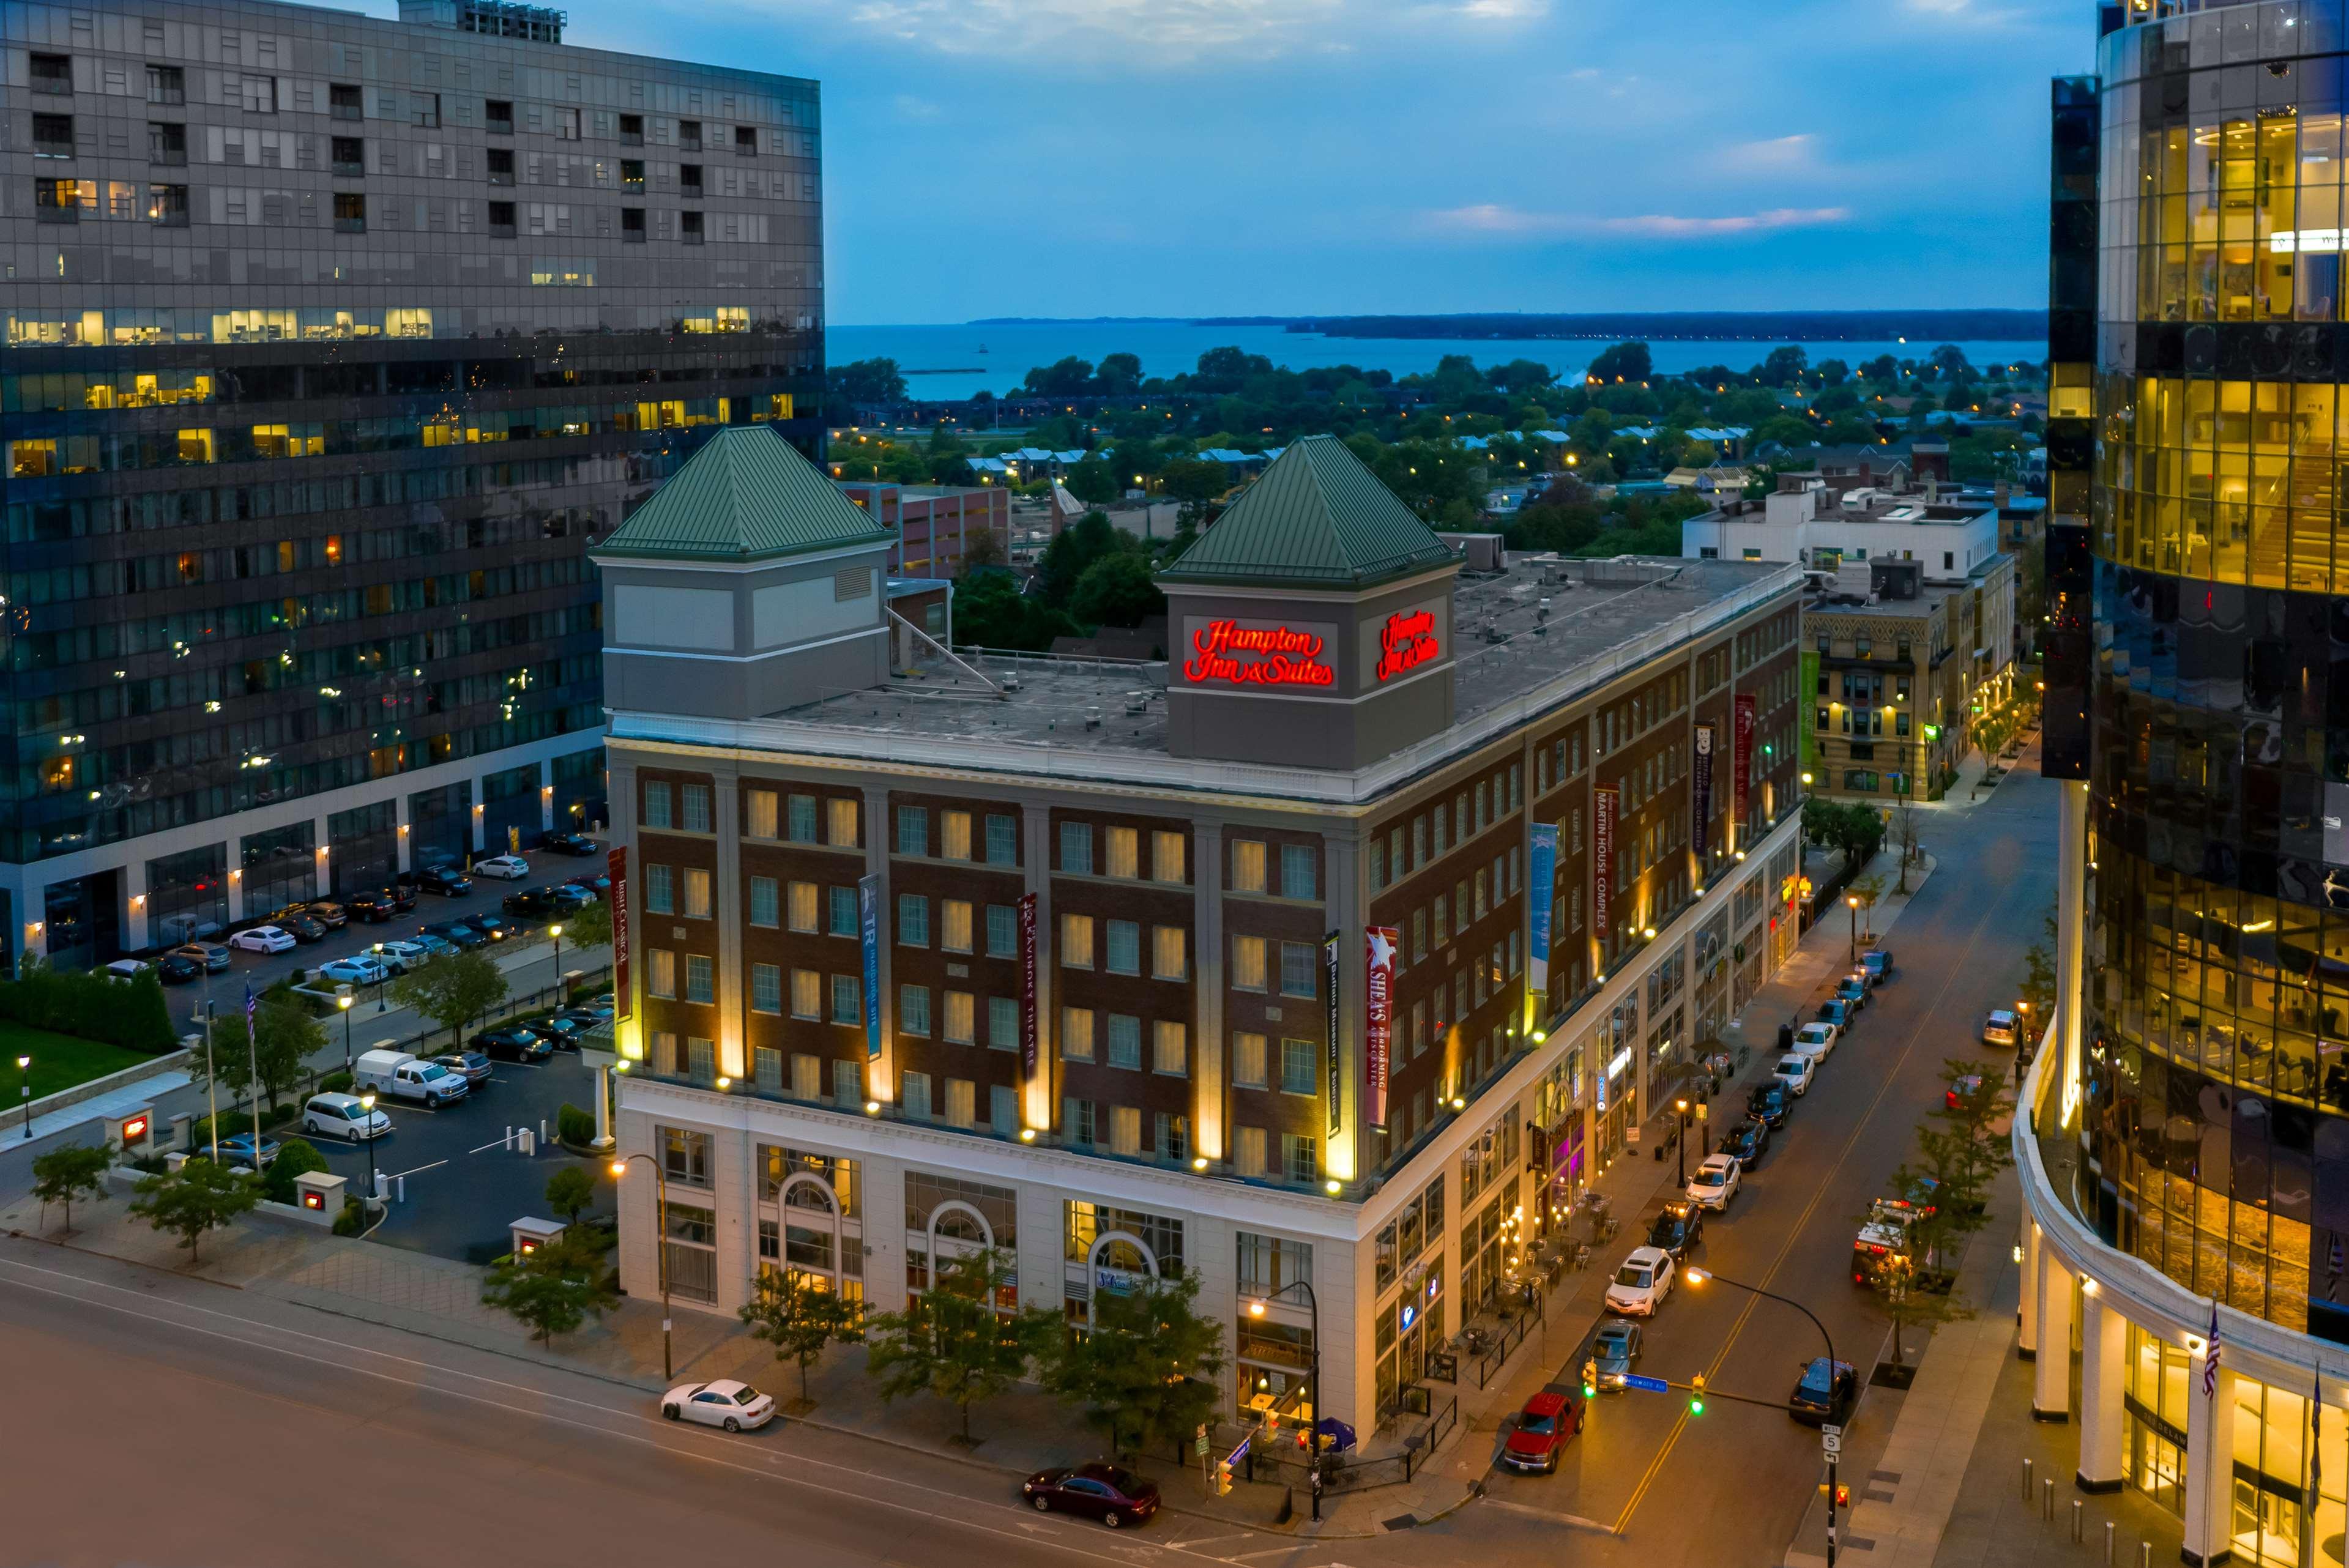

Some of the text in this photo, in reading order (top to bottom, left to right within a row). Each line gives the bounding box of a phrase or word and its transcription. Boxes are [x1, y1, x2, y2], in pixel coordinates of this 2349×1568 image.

[1194, 619, 1323, 657] Hampton
[1382, 609, 1435, 650] Hampton
[1183, 653, 1333, 686] Inn & Suites
[1377, 647, 1405, 681] Inn
[1411, 637, 1439, 666] Suites
[1597, 792, 1606, 929] MARTIN HOUSE COMPLEX
[618, 879, 627, 907] IRISH
[865, 913, 876, 946] TR
[1370, 972, 1387, 1021] SHEA'S
[1625, 1375, 1653, 1388] Delaware
[1828, 1437, 1835, 1447] 5
